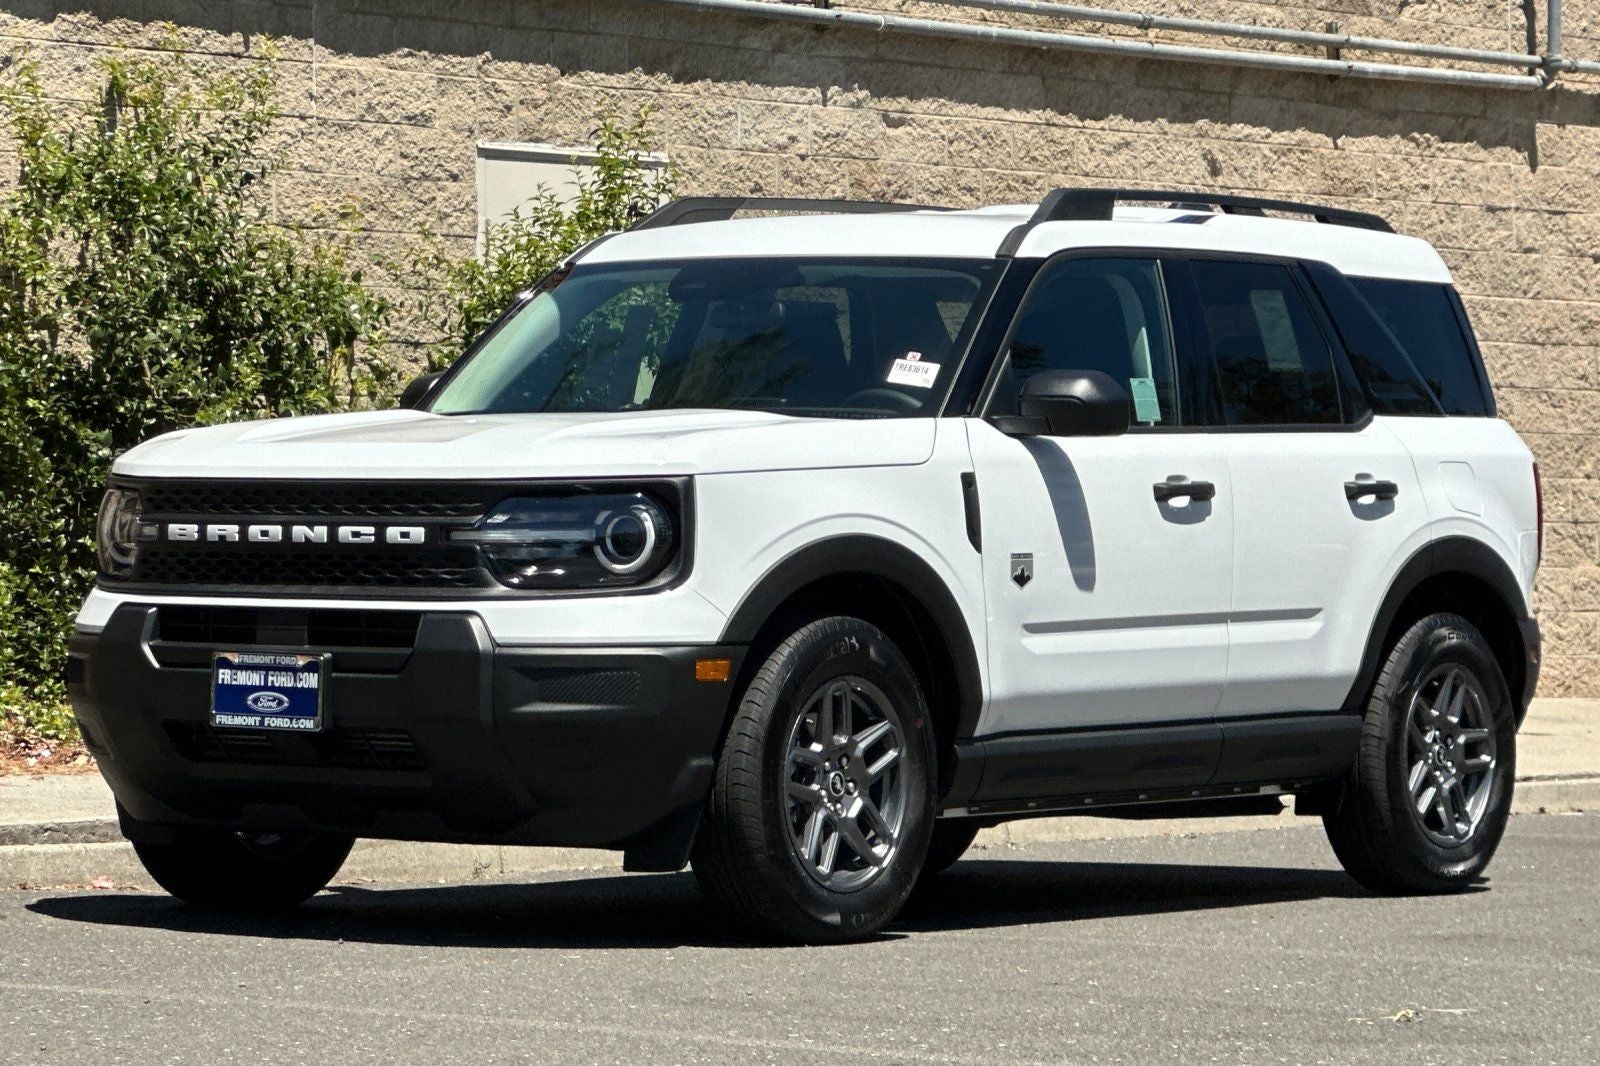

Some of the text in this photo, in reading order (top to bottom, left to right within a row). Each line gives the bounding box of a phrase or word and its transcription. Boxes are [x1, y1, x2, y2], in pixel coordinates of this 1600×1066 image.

[167, 523, 425, 544] BRONCO
[238, 654, 297, 665] FREMONT FORD
[218, 668, 319, 689] FREMONT FORD.COM
[257, 695, 279, 709] Ford
[215, 714, 314, 729] FREMONT FORD.COM
